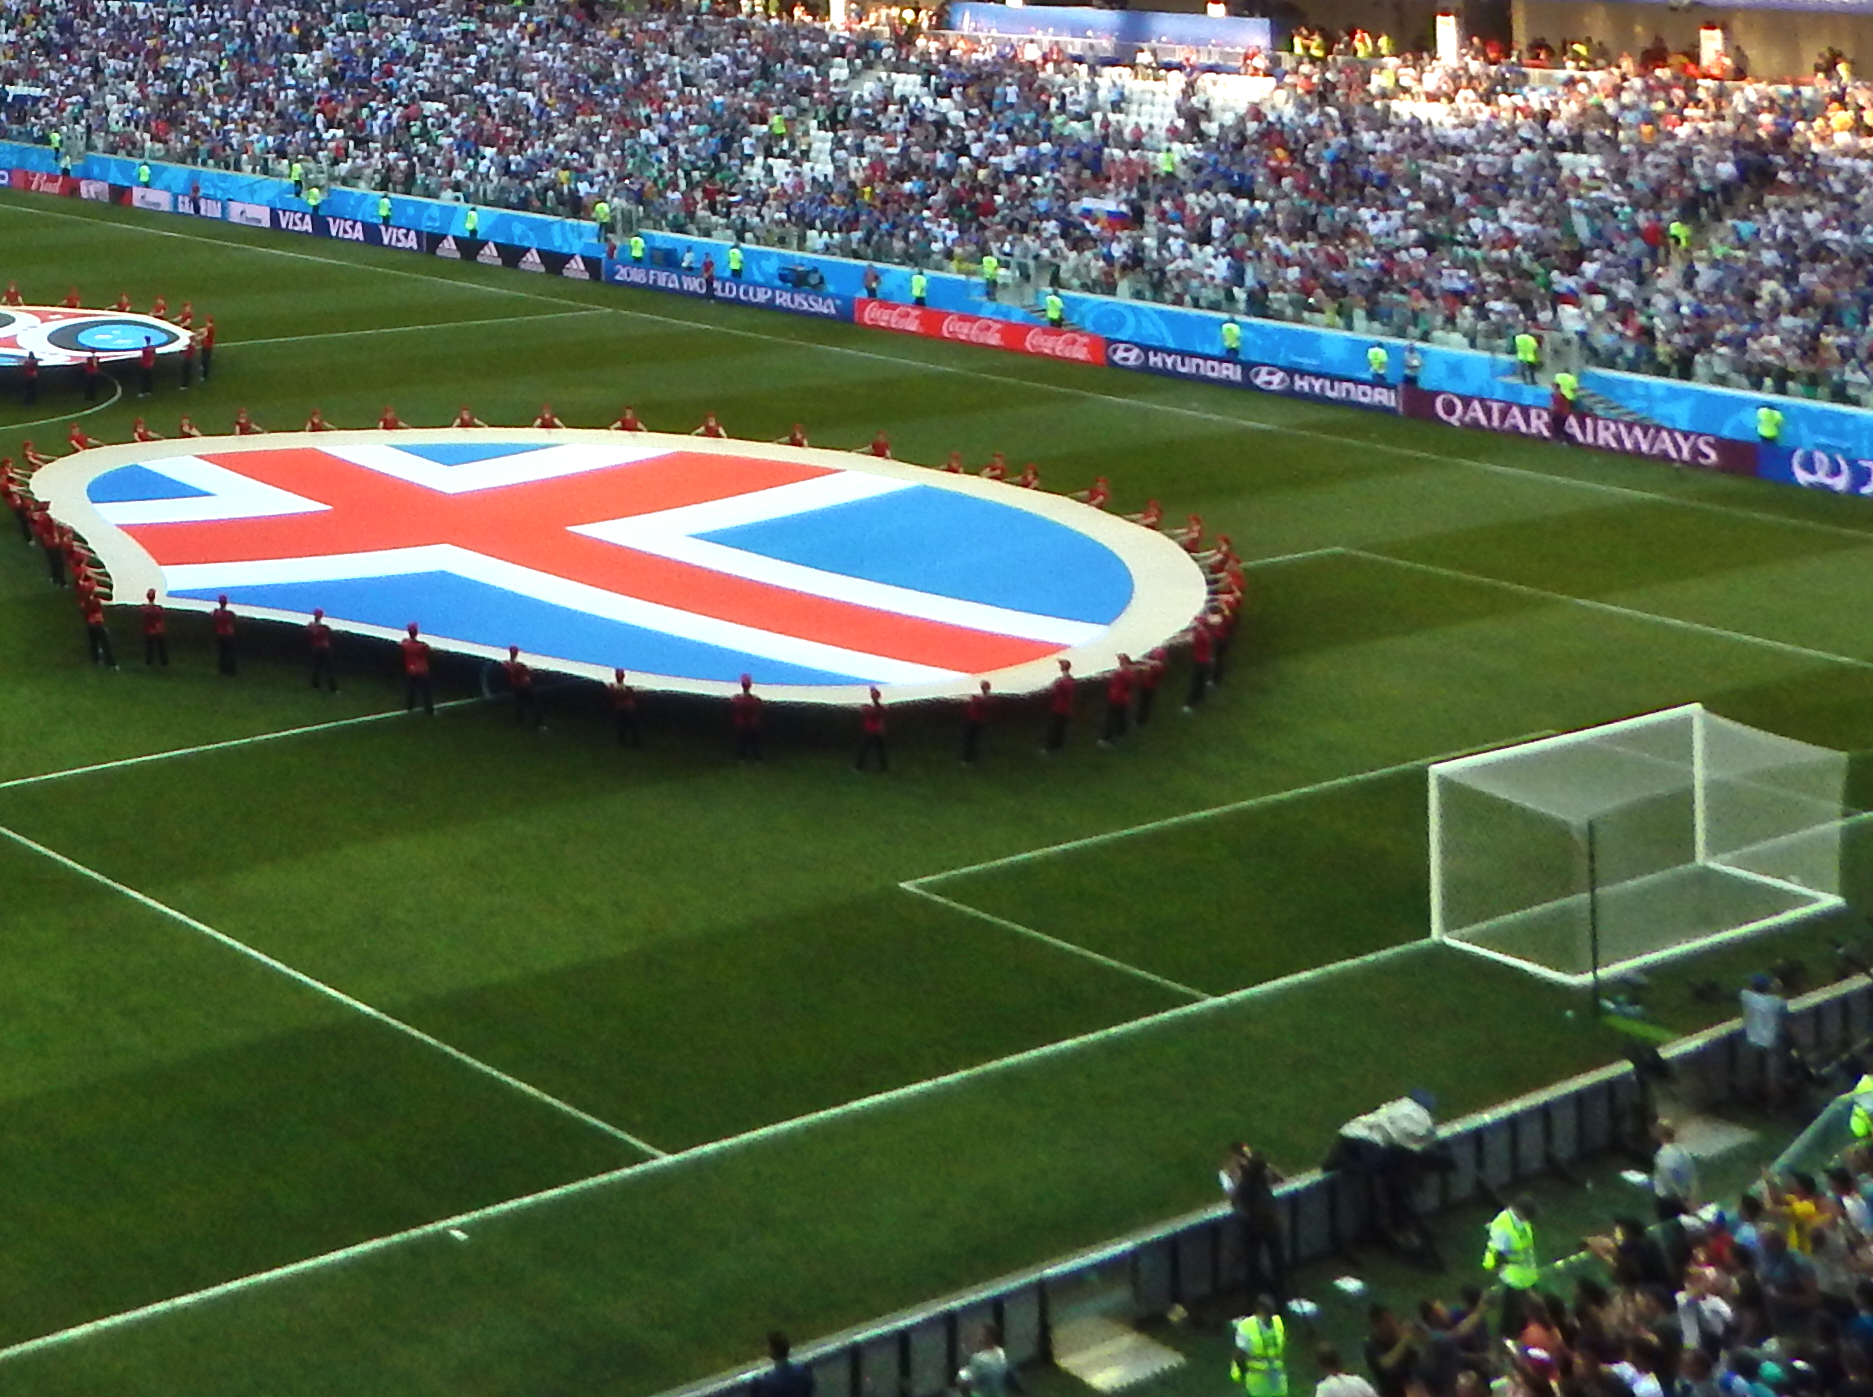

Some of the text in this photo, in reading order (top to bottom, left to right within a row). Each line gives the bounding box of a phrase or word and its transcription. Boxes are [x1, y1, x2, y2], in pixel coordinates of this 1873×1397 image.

[279, 210, 312, 234] VISA
[328, 217, 364, 241] VISA
[380, 225, 418, 250] VISA
[615, 264, 836, 315] 2018 FIFA WOLD CUP RUSSIA
[1148, 349, 1242, 382] HYUNDAI
[1294, 373, 1396, 407] HYUNDAI
[1434, 392, 1719, 466] QATAR AIRWAYS
